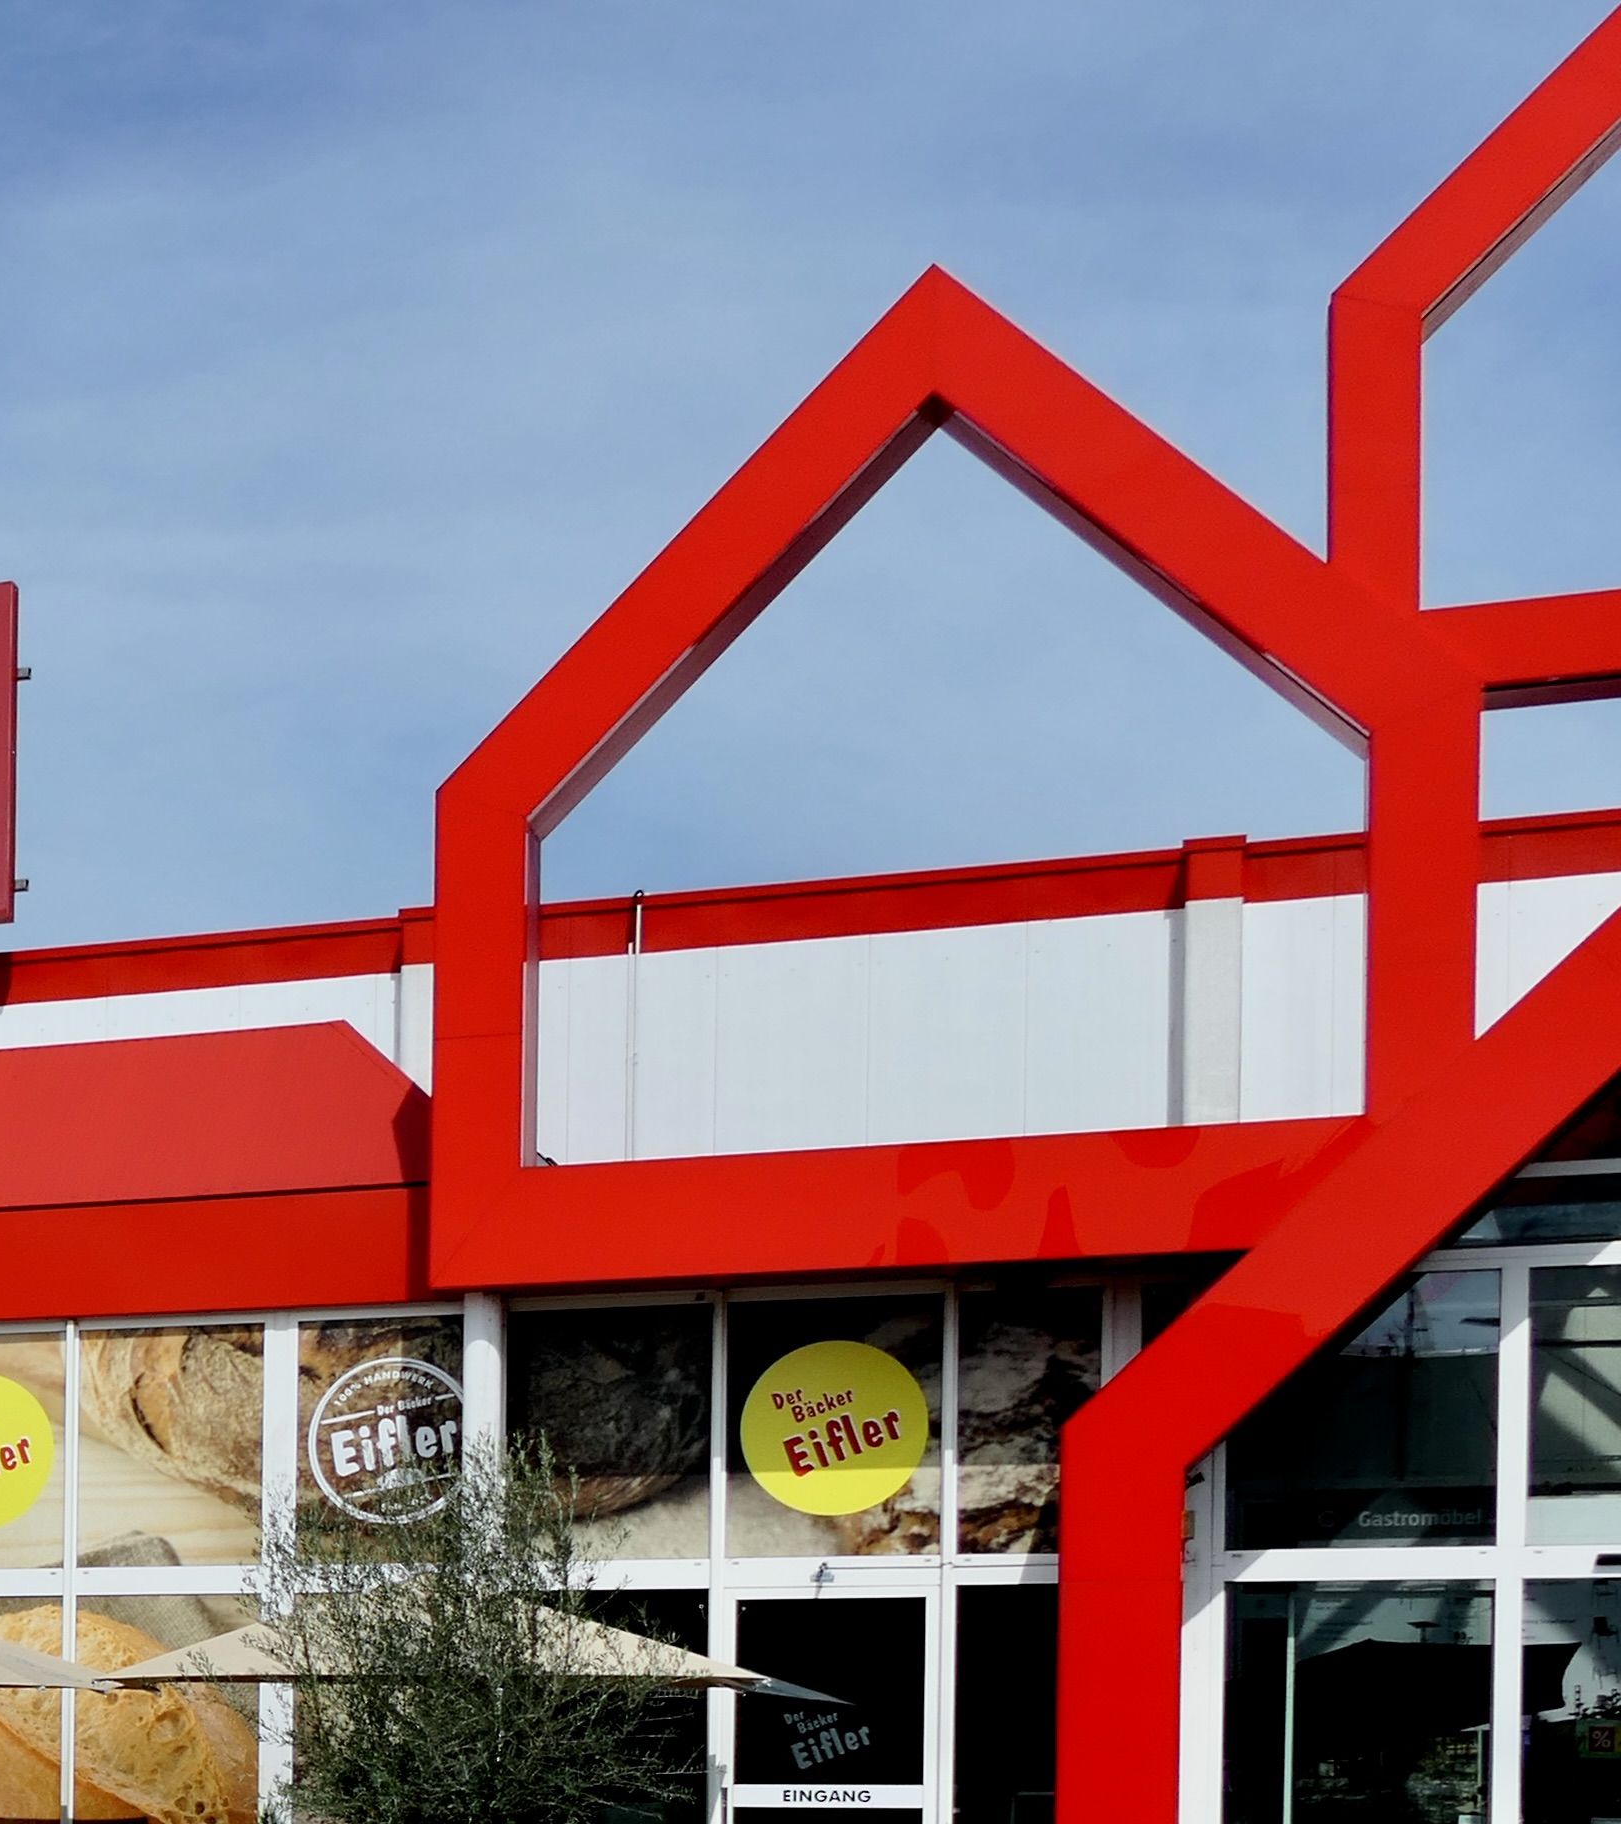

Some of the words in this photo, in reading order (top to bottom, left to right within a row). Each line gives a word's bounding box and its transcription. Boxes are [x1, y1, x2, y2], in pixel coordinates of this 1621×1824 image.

[333, 1381, 362, 1407] 100%
[363, 1370, 434, 1390] HANDWERK
[771, 1388, 803, 1410] Der
[376, 1404, 395, 1416] Der
[791, 1389, 854, 1423] Bäcker
[330, 1414, 457, 1478] Eifler
[782, 1410, 901, 1477] Eifler
[1358, 1508, 1482, 1527] Gastromöbel
[783, 1711, 805, 1725] Der
[797, 1712, 838, 1734] Bäcker
[790, 1726, 870, 1769] Eifler
[783, 1790, 872, 1803] EINGANG
